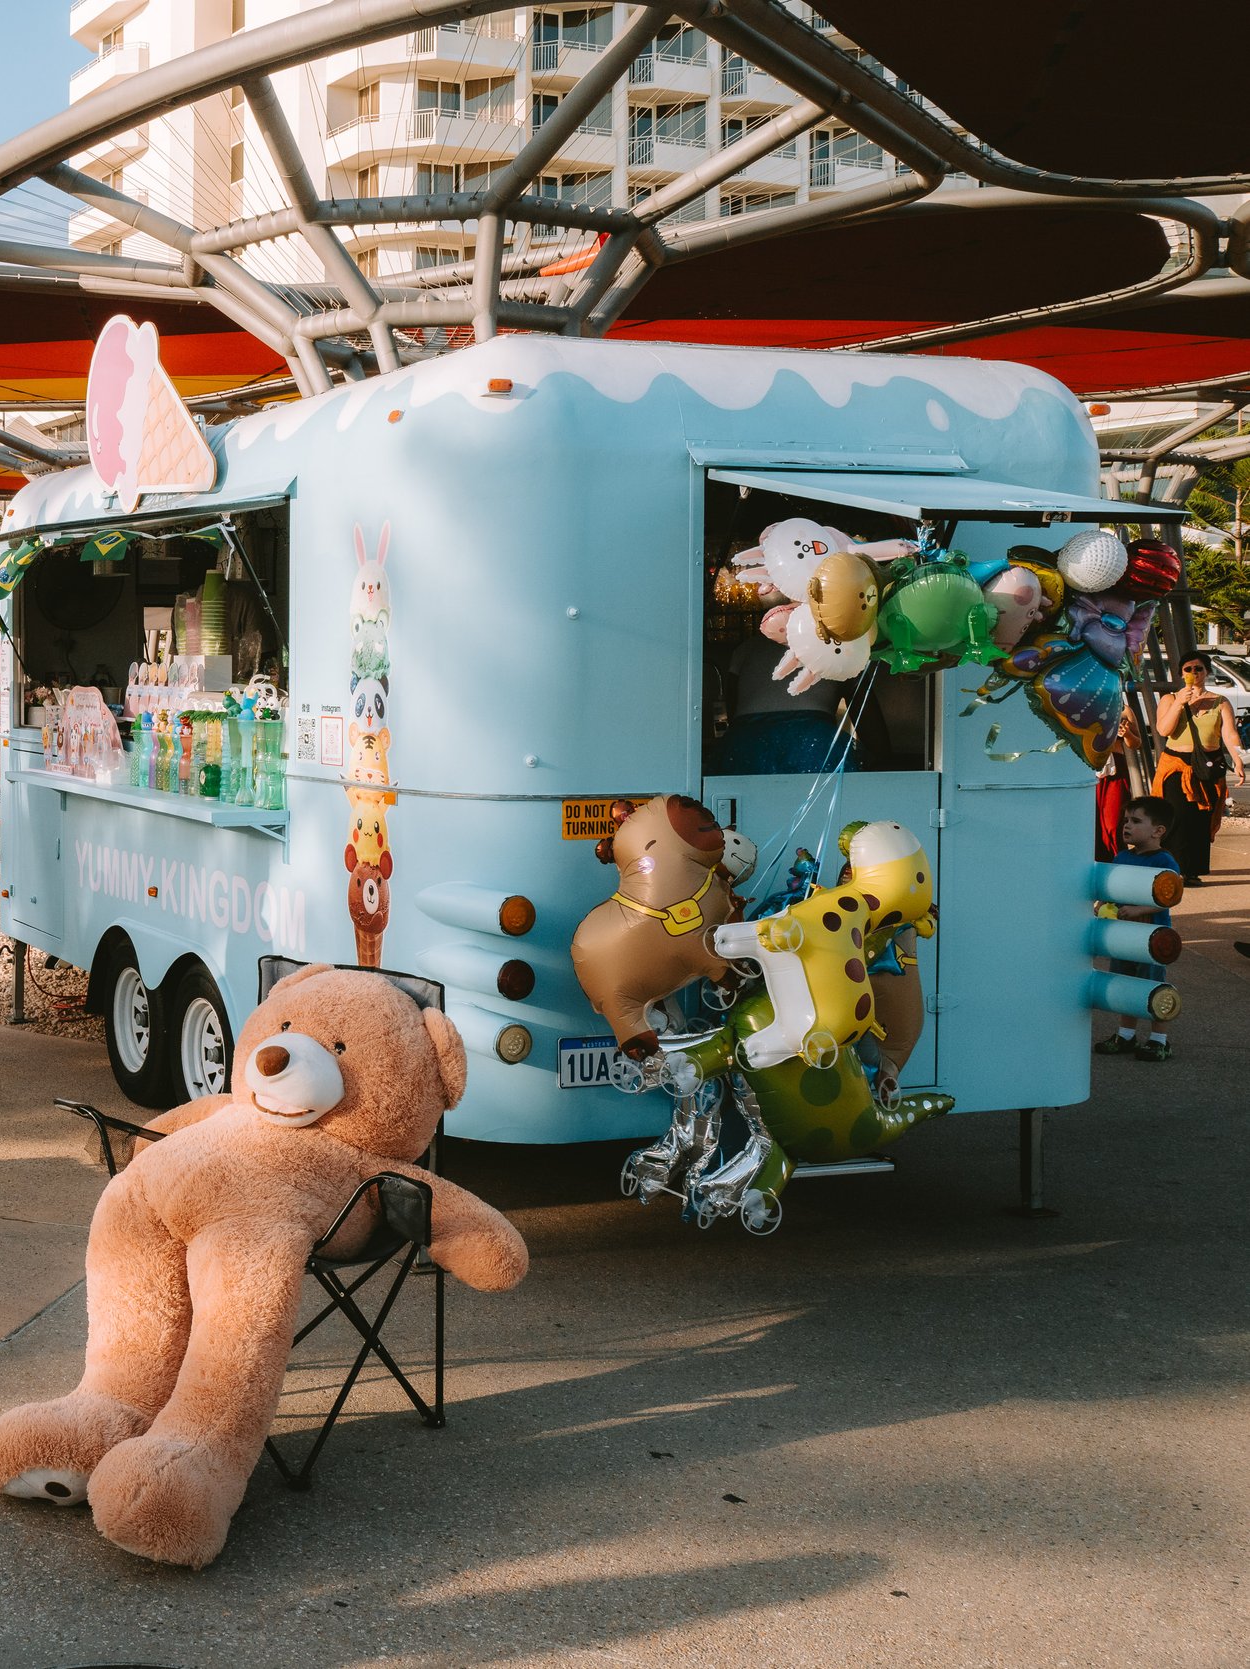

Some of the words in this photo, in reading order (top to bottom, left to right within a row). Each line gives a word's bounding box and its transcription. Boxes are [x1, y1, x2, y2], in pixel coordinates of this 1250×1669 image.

[565, 805, 581, 819] DO
[584, 804, 607, 818] NOT
[565, 820, 615, 835] TURNING
[75, 839, 154, 907] YUMMY
[161, 856, 306, 954] KINGDOM
